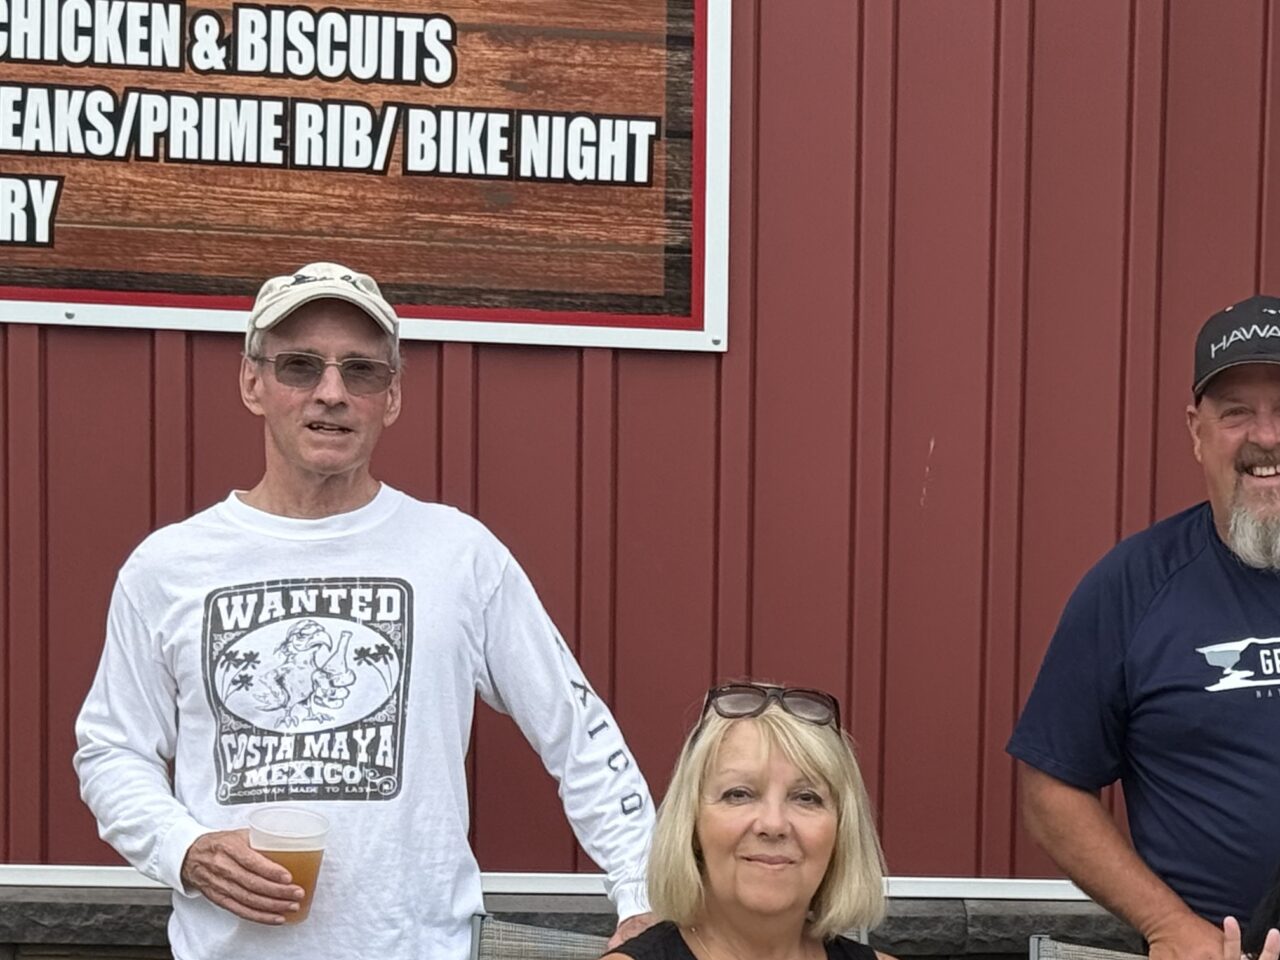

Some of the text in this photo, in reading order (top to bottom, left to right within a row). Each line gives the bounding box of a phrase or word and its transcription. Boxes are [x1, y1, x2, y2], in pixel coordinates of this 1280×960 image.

[0, 0, 453, 84] HICKEN & BISCUITS
[295, 102, 398, 170] RIB/
[407, 108, 510, 175] BIKE
[519, 114, 656, 182] NIGHT
[217, 588, 401, 631] WANTED
[303, 725, 394, 769] MAYA
[243, 760, 362, 788] MEXICO
[289, 786, 319, 795] MADE
[324, 786, 340, 794] TO
